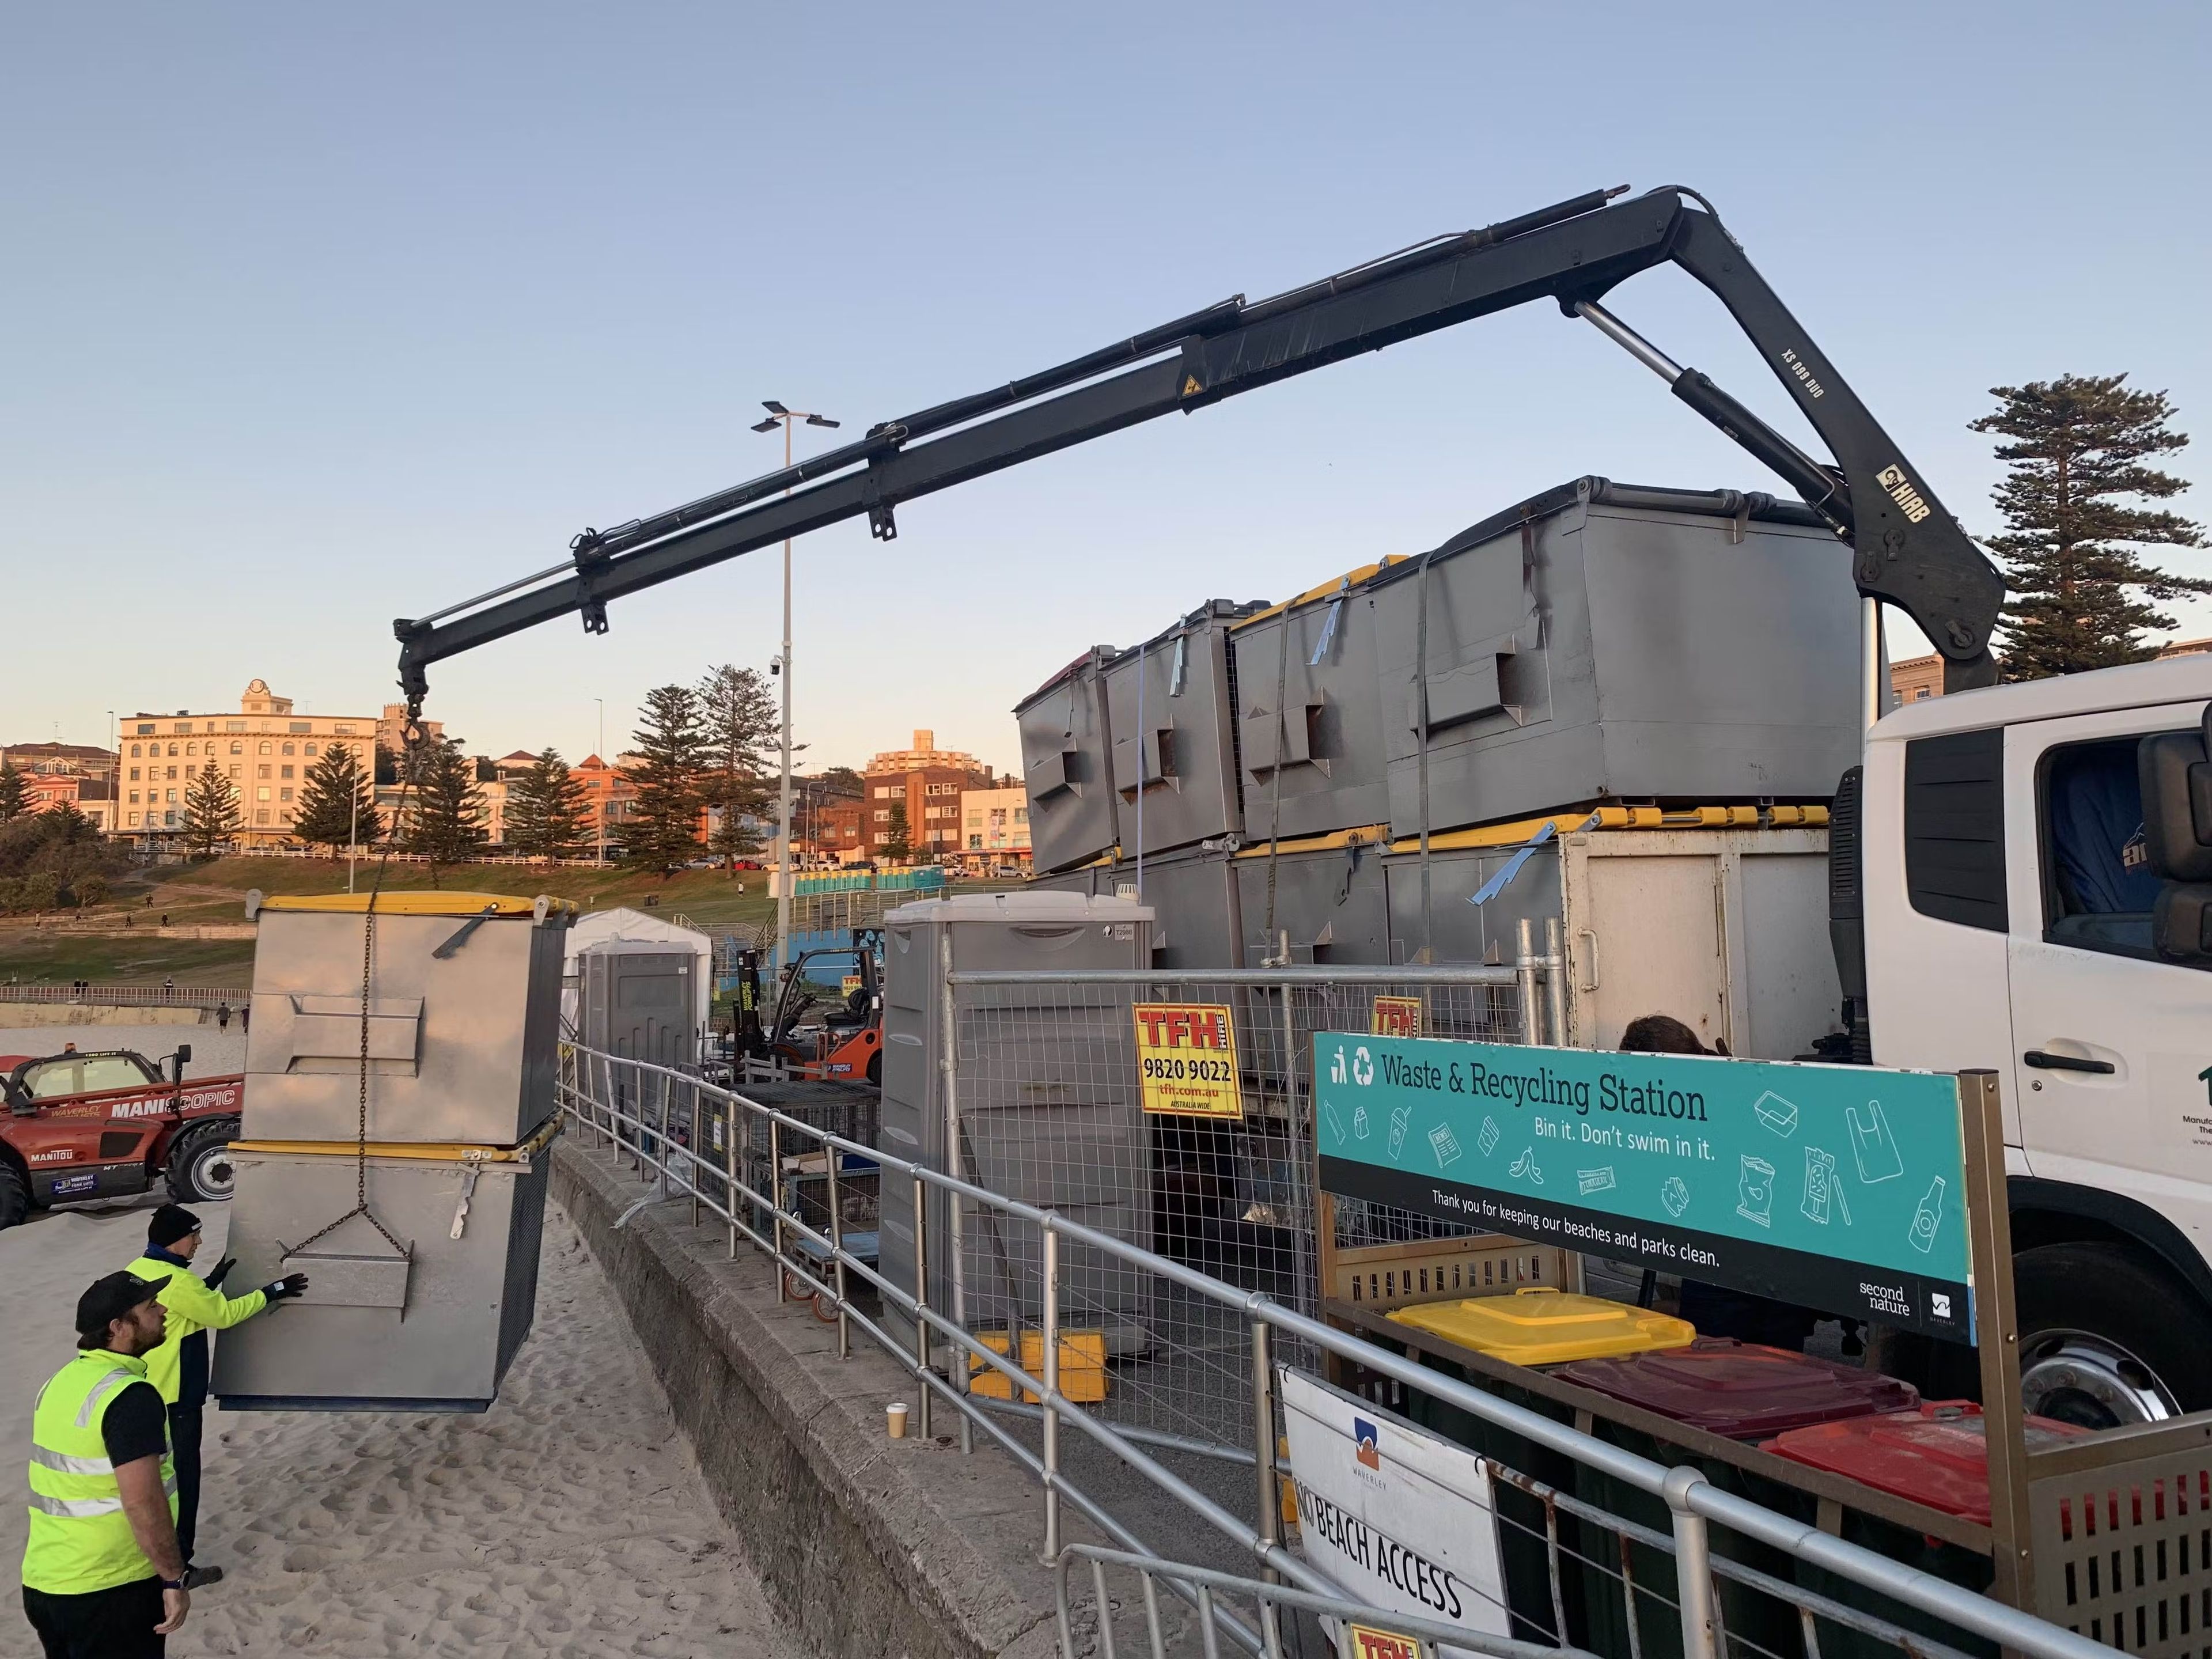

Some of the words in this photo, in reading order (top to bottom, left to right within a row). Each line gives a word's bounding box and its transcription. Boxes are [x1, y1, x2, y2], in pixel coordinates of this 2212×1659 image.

[1781, 349, 1796, 363] XS
[1791, 362, 1810, 380] 099
[1805, 378, 1824, 398] DUO
[1891, 482, 1930, 523] HIAB
[1138, 1011, 1219, 1049] TFH
[1215, 1014, 1228, 1050] HIRE
[1376, 1003, 1414, 1037] TFH
[1144, 1058, 1184, 1080] 9820
[1188, 1060, 1231, 1081] 9022
[1160, 1083, 1219, 1097] tfh.com.au
[1381, 1054, 1441, 1090] Waste
[1449, 1062, 1465, 1093] &
[1470, 1062, 1590, 1115] Recycling
[1600, 1073, 1708, 1122] Station
[51, 1105, 101, 1117] WAVERLEY
[1171, 1100, 1196, 1109] AUSTRALIA
[1197, 1102, 1210, 1110] WIDE
[1535, 1116, 1556, 1138] Bin
[1562, 1119, 1575, 1141] it.
[1628, 1131, 1669, 1154] swim
[1676, 1134, 1691, 1157] in
[1698, 1137, 1715, 1160] it.
[31, 1149, 73, 1162] MANITOU
[1432, 1189, 1460, 1209] Thank
[1462, 1199, 1479, 1214] you
[1482, 1199, 1497, 1217] for
[1500, 1203, 1539, 1230] keeping
[1542, 1217, 1561, 1232] our
[1565, 1217, 1611, 1243] beaches
[1615, 1232, 1637, 1249] and
[1641, 1238, 1676, 1257] parks
[1680, 1243, 1719, 1267] clean.
[1859, 1282, 1904, 1302] second
[1870, 1297, 1910, 1316] nature
[1930, 1317, 1955, 1325] WAVERLEY
[1353, 1466, 1387, 1491] WAVERLEY
[1294, 1477, 1314, 1527] NO
[1315, 1497, 1370, 1570] BEACH
[1378, 1535, 1461, 1619] ACCESS
